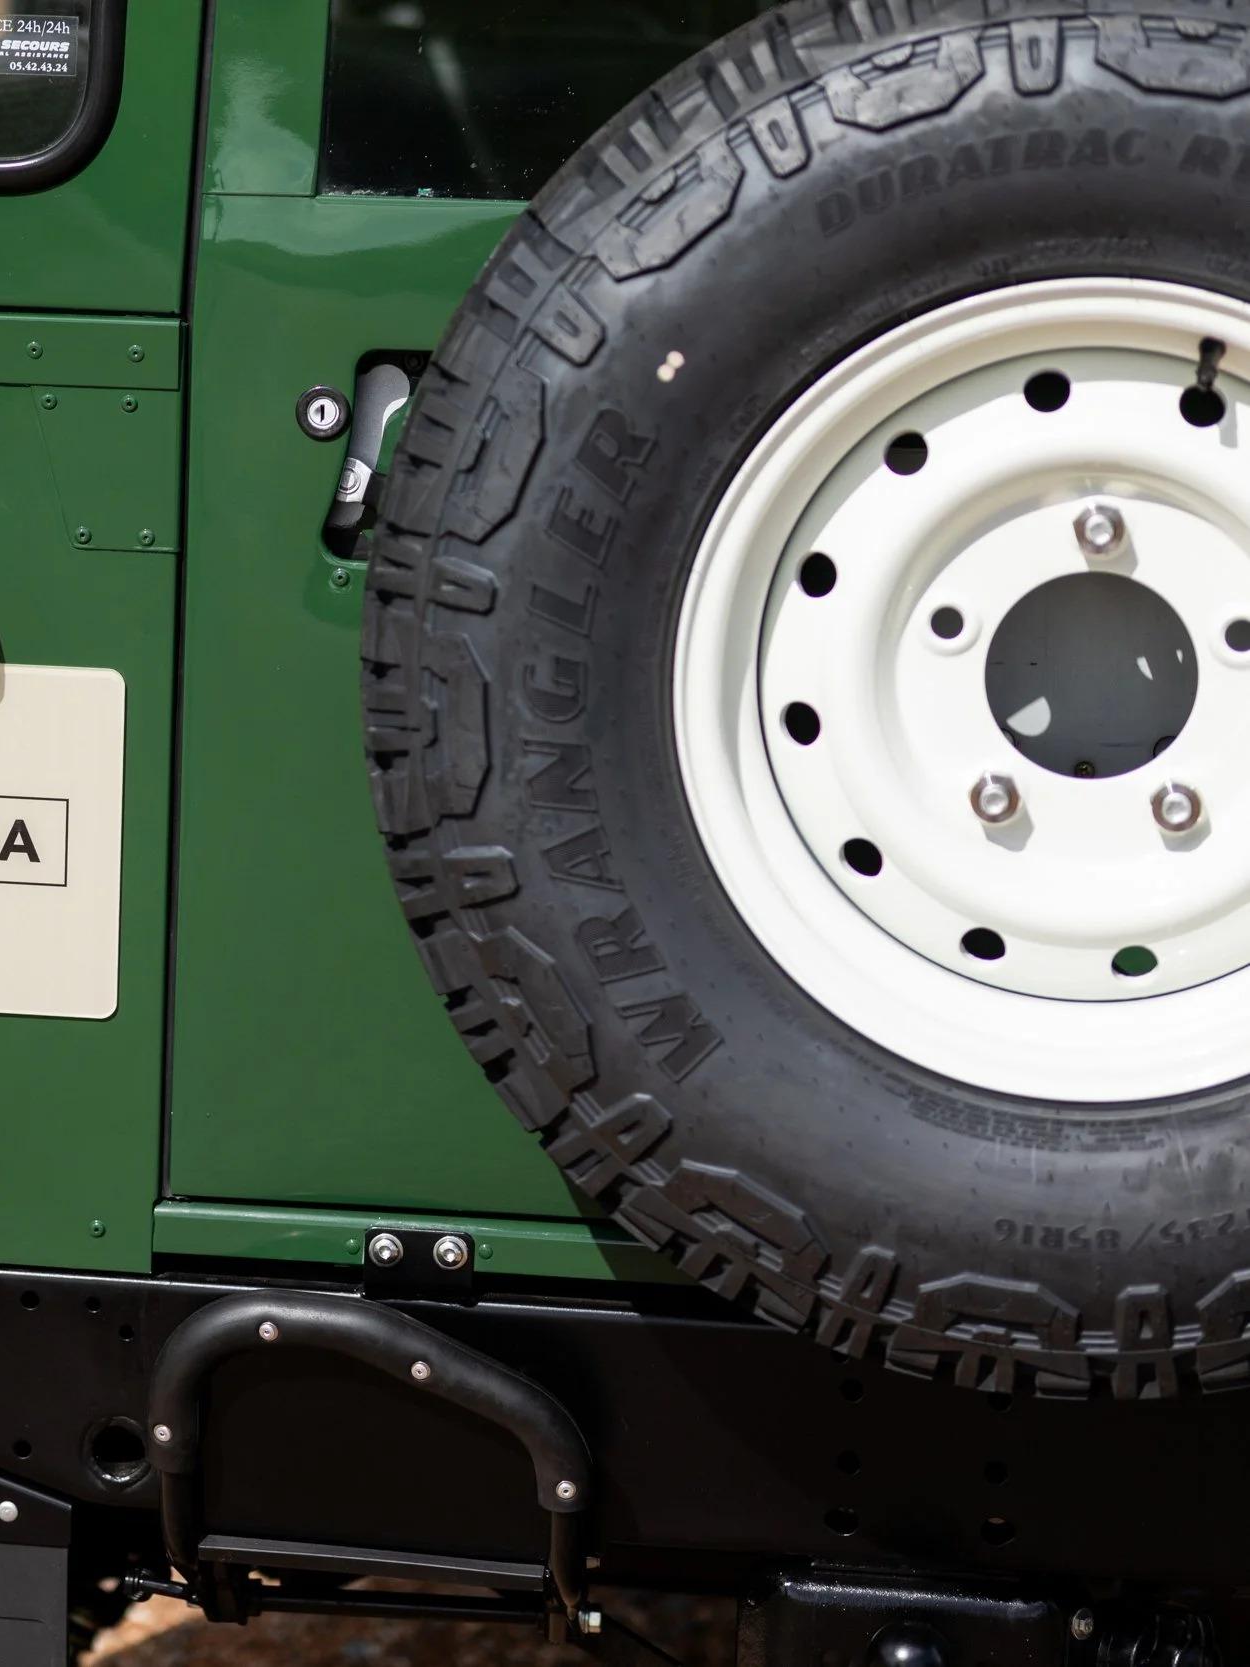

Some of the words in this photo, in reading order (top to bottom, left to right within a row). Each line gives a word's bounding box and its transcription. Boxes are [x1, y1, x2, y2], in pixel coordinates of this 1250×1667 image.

[17, 20, 70, 36] 24h/24h
[1, 40, 70, 52] SECOURS
[9, 61, 68, 72] 05.42.43.24
[817, 128, 1147, 238] DURATRAC
[521, 407, 725, 1084] WRANGLER
